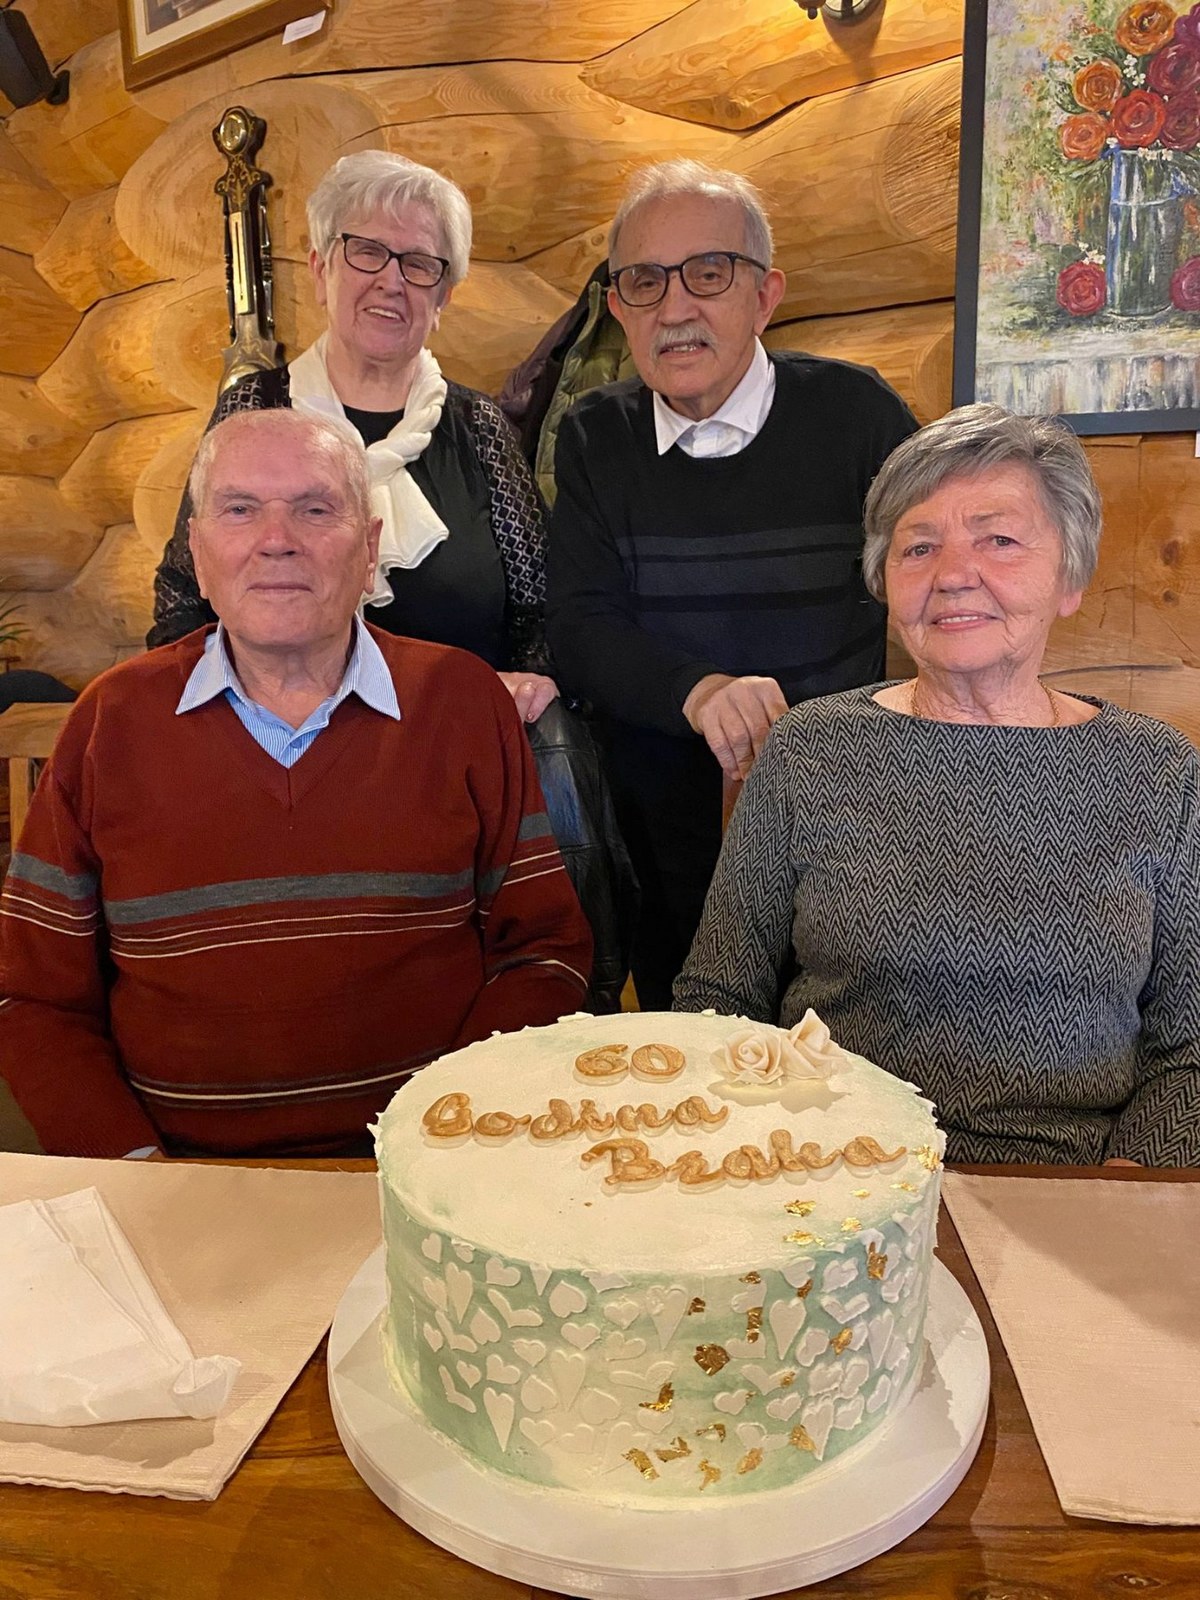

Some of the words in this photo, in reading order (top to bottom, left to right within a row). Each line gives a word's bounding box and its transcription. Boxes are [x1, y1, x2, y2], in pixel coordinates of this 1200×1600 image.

[574, 1042, 686, 1080] 60
[422, 1092, 729, 1141] Godina
[581, 1129, 907, 1187] Braka
